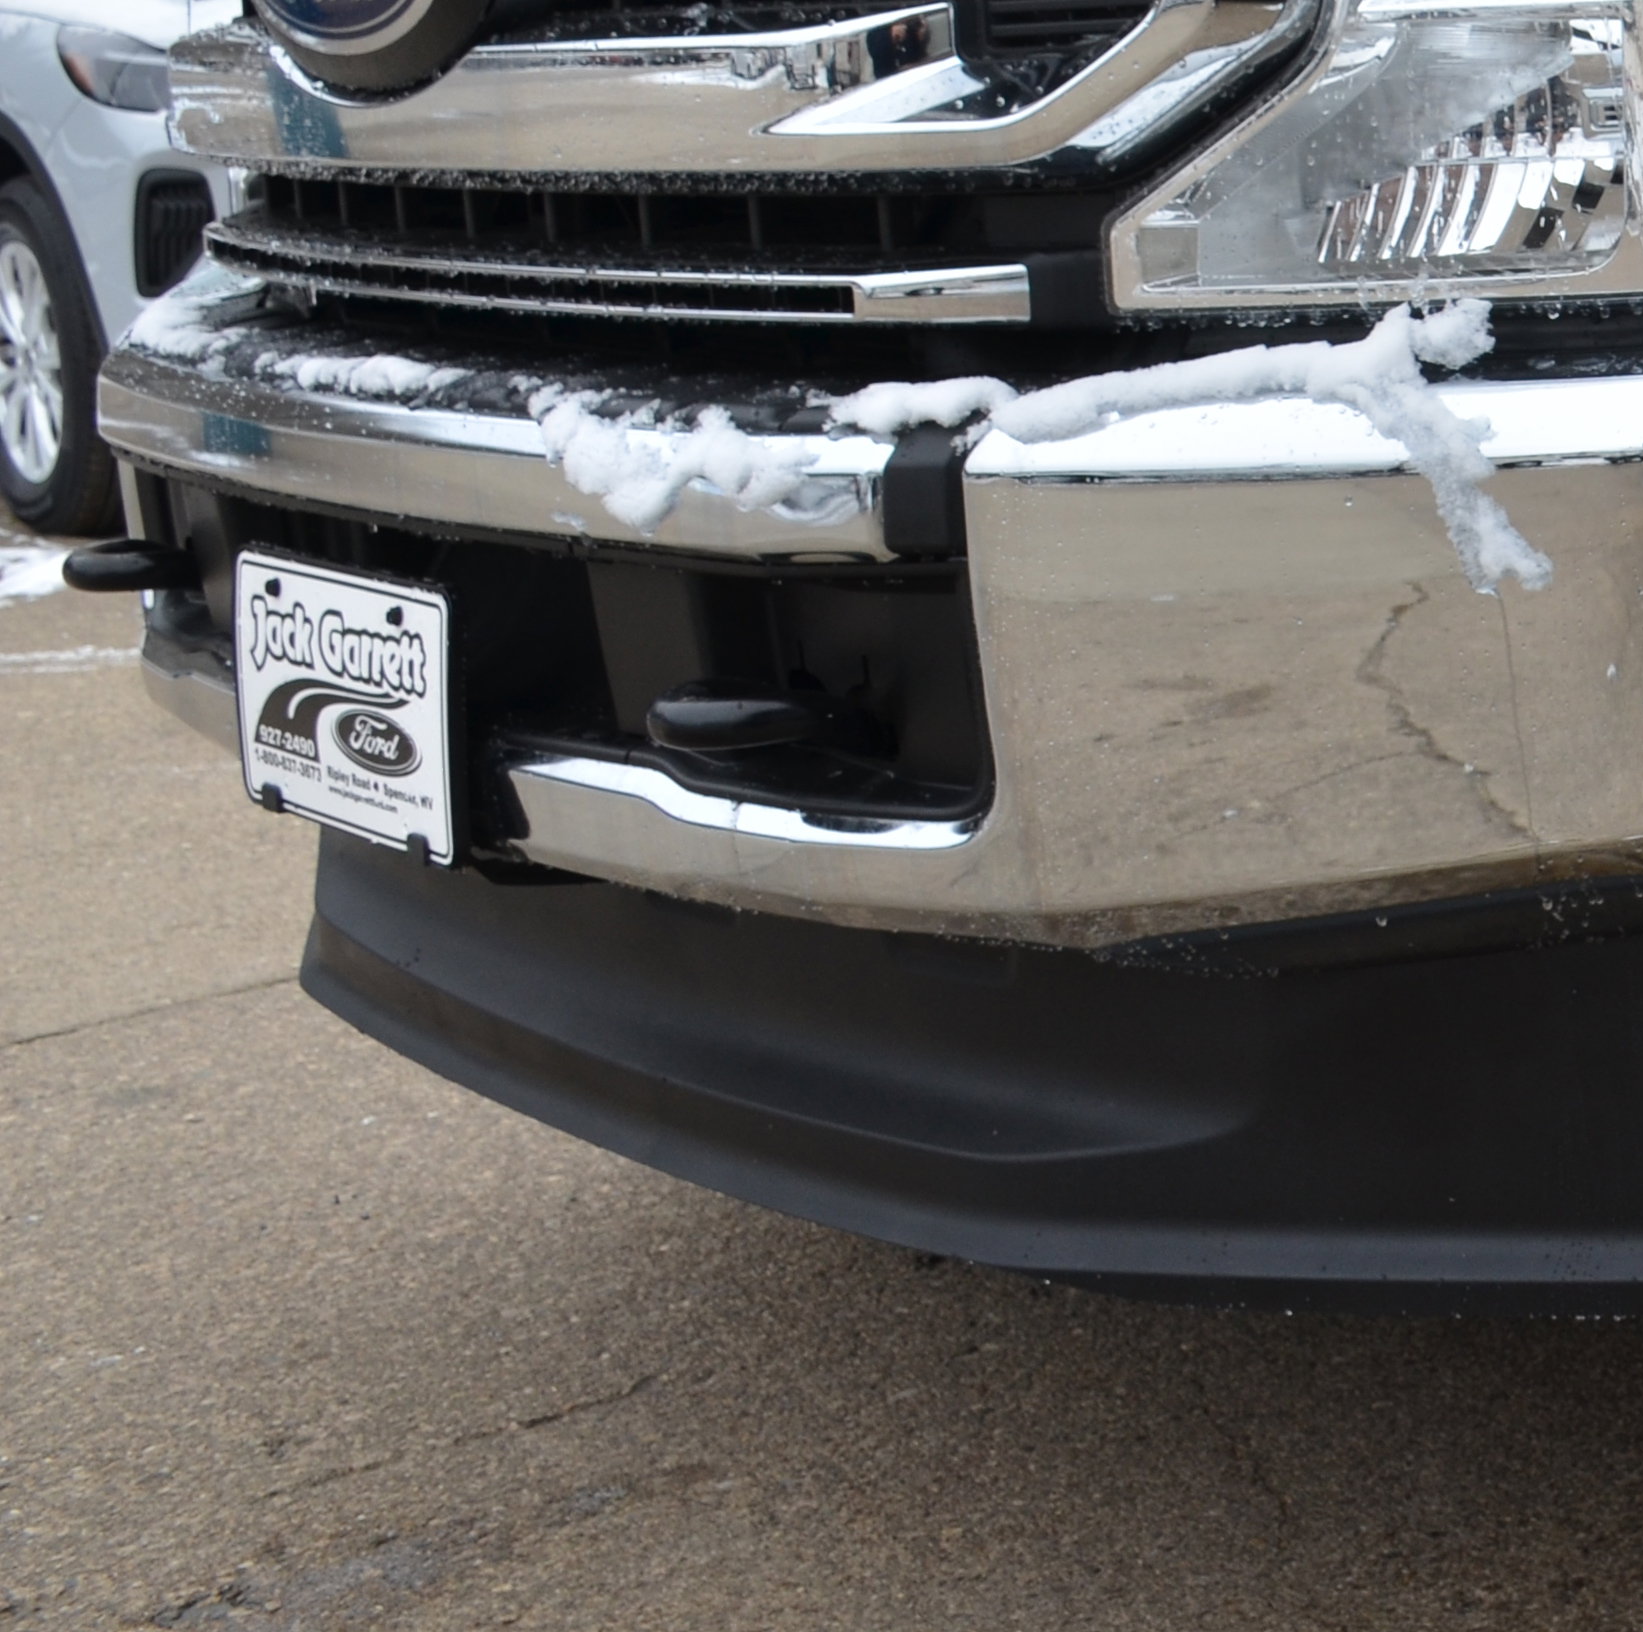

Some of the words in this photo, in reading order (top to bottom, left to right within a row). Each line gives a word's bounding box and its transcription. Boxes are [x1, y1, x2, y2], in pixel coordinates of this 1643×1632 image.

[250, 594, 315, 672] Jack
[319, 608, 427, 699] Garrett
[349, 714, 400, 761] Ford
